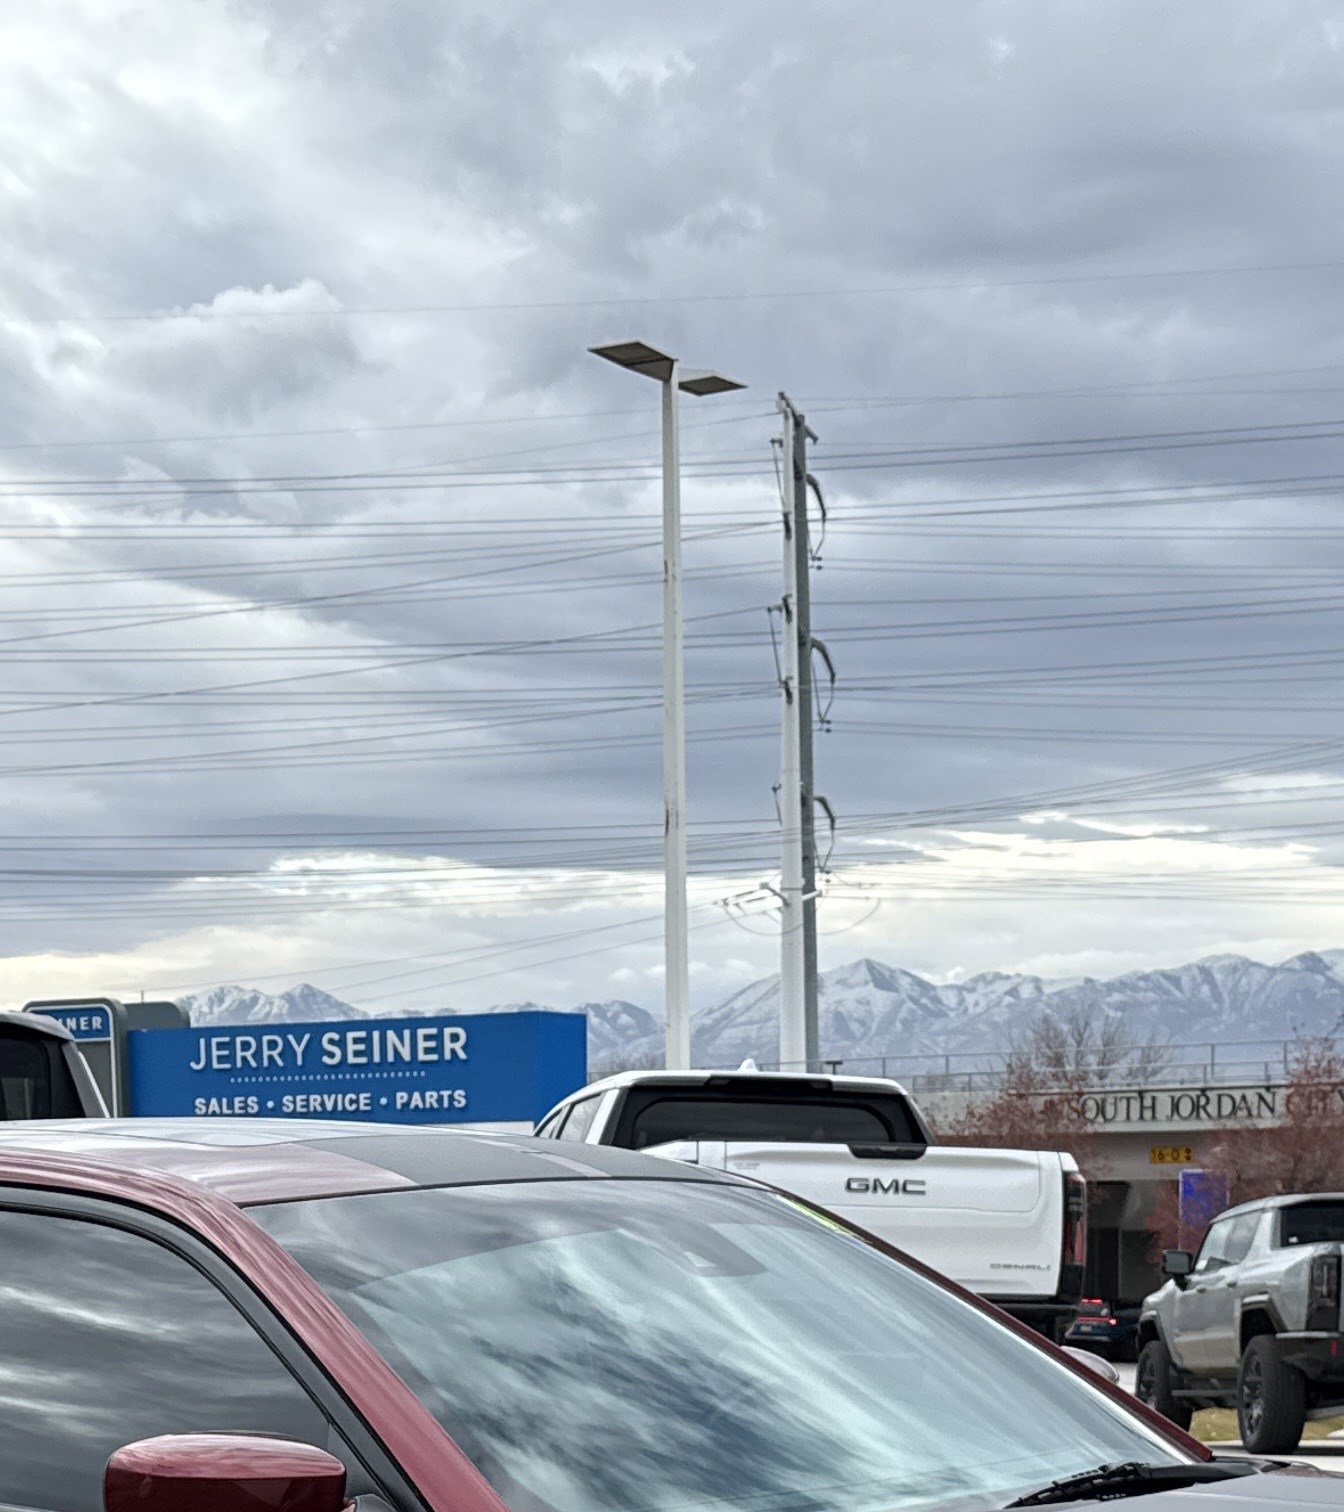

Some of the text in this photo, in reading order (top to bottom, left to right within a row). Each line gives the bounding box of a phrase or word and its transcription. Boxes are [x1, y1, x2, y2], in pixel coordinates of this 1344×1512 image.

[189, 1026, 468, 1071] JERRY SEINER
[194, 1089, 467, 1116] SALES SERVICE PARTS
[1165, 1088, 1277, 1119] JORDAN
[845, 1177, 927, 1196] GMC
